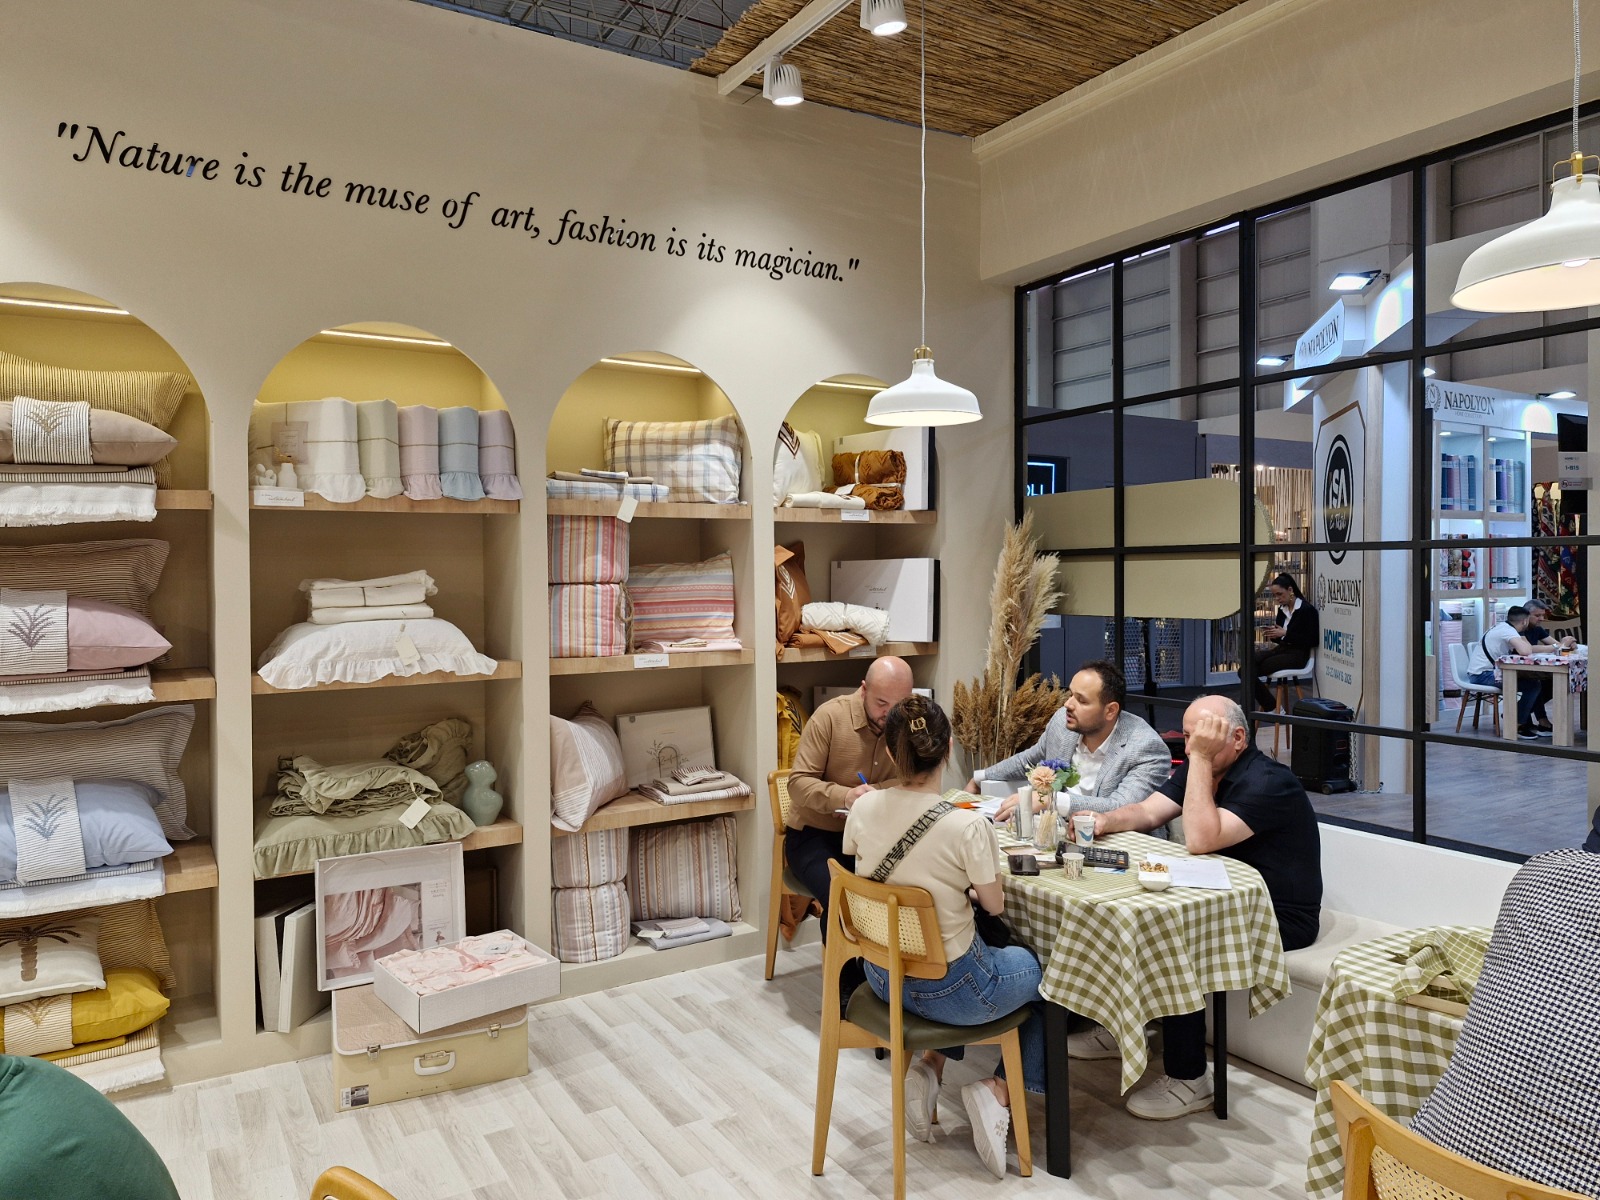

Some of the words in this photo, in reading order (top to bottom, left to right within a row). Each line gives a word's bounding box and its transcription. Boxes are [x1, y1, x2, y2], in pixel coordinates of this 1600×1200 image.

[57, 121, 220, 181] "Nature
[234, 151, 266, 188] is
[280, 161, 332, 198] the
[344, 182, 430, 215] muse
[441, 191, 481, 230] of
[490, 206, 541, 239] art,
[547, 209, 657, 252] fashion
[666, 226, 688, 257] is
[697, 232, 726, 263] its
[734, 247, 860, 282] magician."
[1443, 390, 1495, 416] NAPOLYON
[1327, 578, 1361, 608] NAPOLYON
